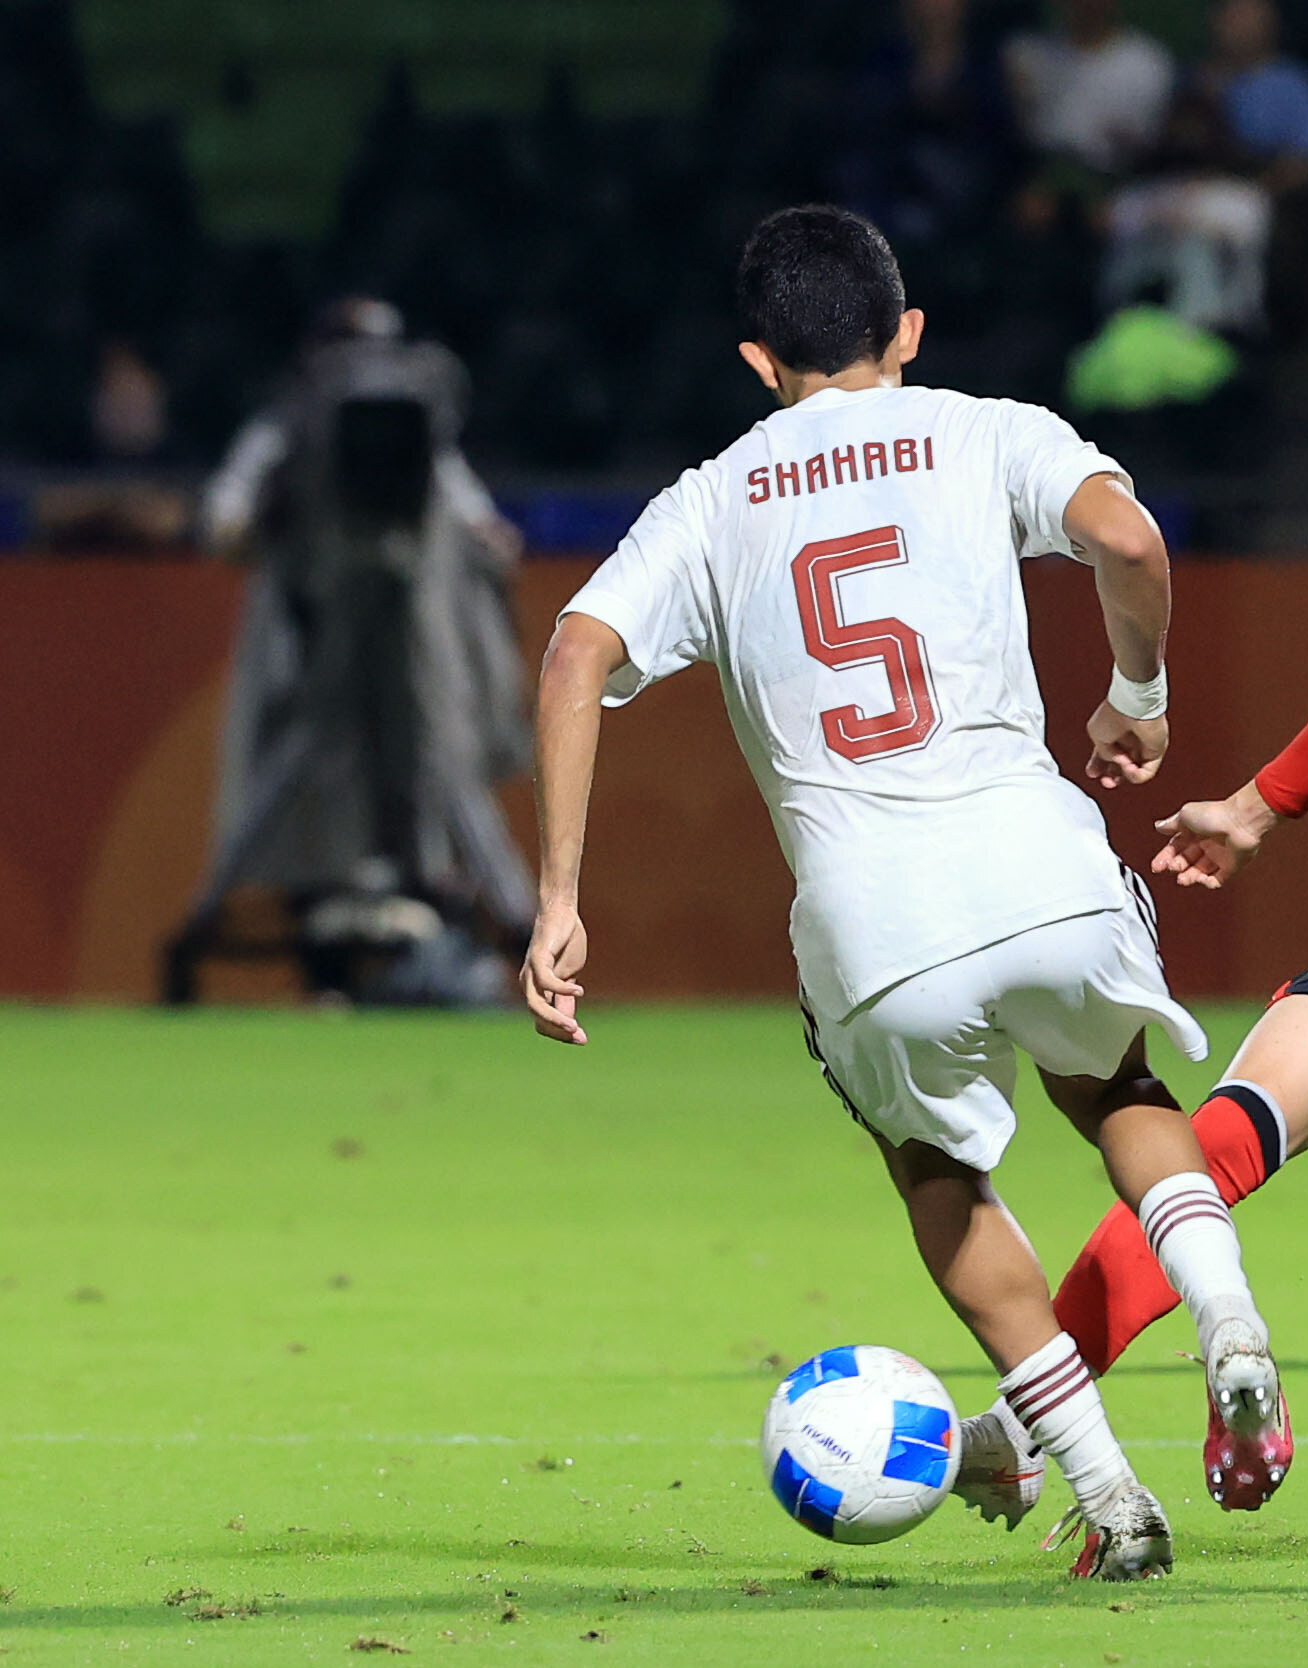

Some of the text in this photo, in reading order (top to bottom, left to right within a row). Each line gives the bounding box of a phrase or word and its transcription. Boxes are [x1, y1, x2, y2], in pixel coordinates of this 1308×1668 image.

[748, 437, 934, 504] SHAHABI
[790, 525, 943, 765] 5
[801, 1424, 852, 1464] molten
